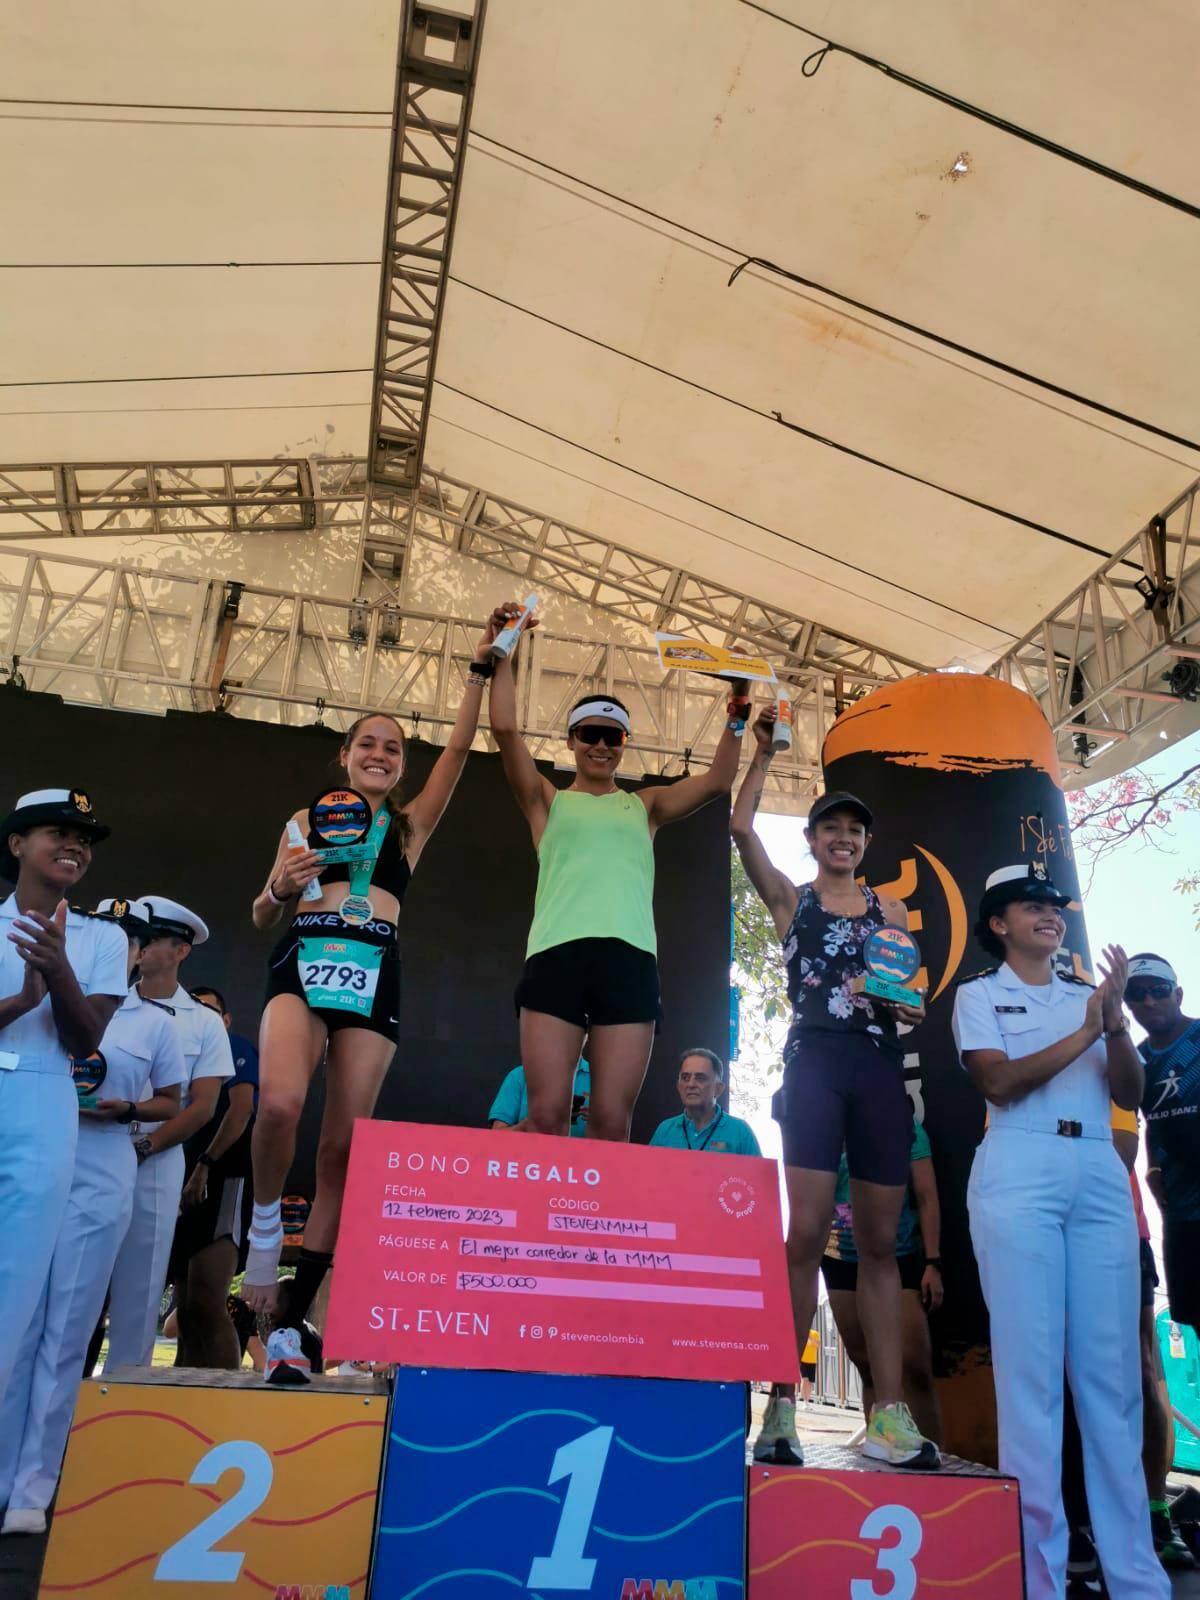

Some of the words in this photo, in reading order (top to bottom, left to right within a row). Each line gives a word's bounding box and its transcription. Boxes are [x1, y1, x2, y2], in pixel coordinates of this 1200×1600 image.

[331, 793, 348, 802] 21K
[328, 812, 354, 821] MMM
[292, 914, 340, 928] NIKE
[888, 932, 904, 942] 21K
[305, 965, 367, 991] 2793
[388, 1152, 470, 1175] BONO
[487, 1160, 600, 1185] REGALO
[384, 1184, 426, 1197] FECHA
[384, 1203, 401, 1216] 12
[466, 1208, 503, 1225] 2023
[719, 1197, 734, 1215] amor
[735, 1200, 756, 1219] propio
[378, 1234, 437, 1249] PÁGUESE
[440, 1239, 449, 1250] A
[461, 1239, 477, 1255] El
[484, 1245, 519, 1262] mejor
[526, 1246, 579, 1261] corredor
[585, 1248, 599, 1262] de
[604, 1250, 617, 1264] la
[626, 1252, 672, 1270] MMM
[384, 1270, 426, 1283] VALOR
[430, 1273, 447, 1284] DE
[459, 1274, 537, 1290] $500.000
[561, 1332, 645, 1345] stevencolombia
[672, 1337, 769, 1351] www.stevensa.com
[153, 1440, 274, 1583] 2
[526, 1426, 614, 1590] 1
[850, 1504, 923, 1600] 3
